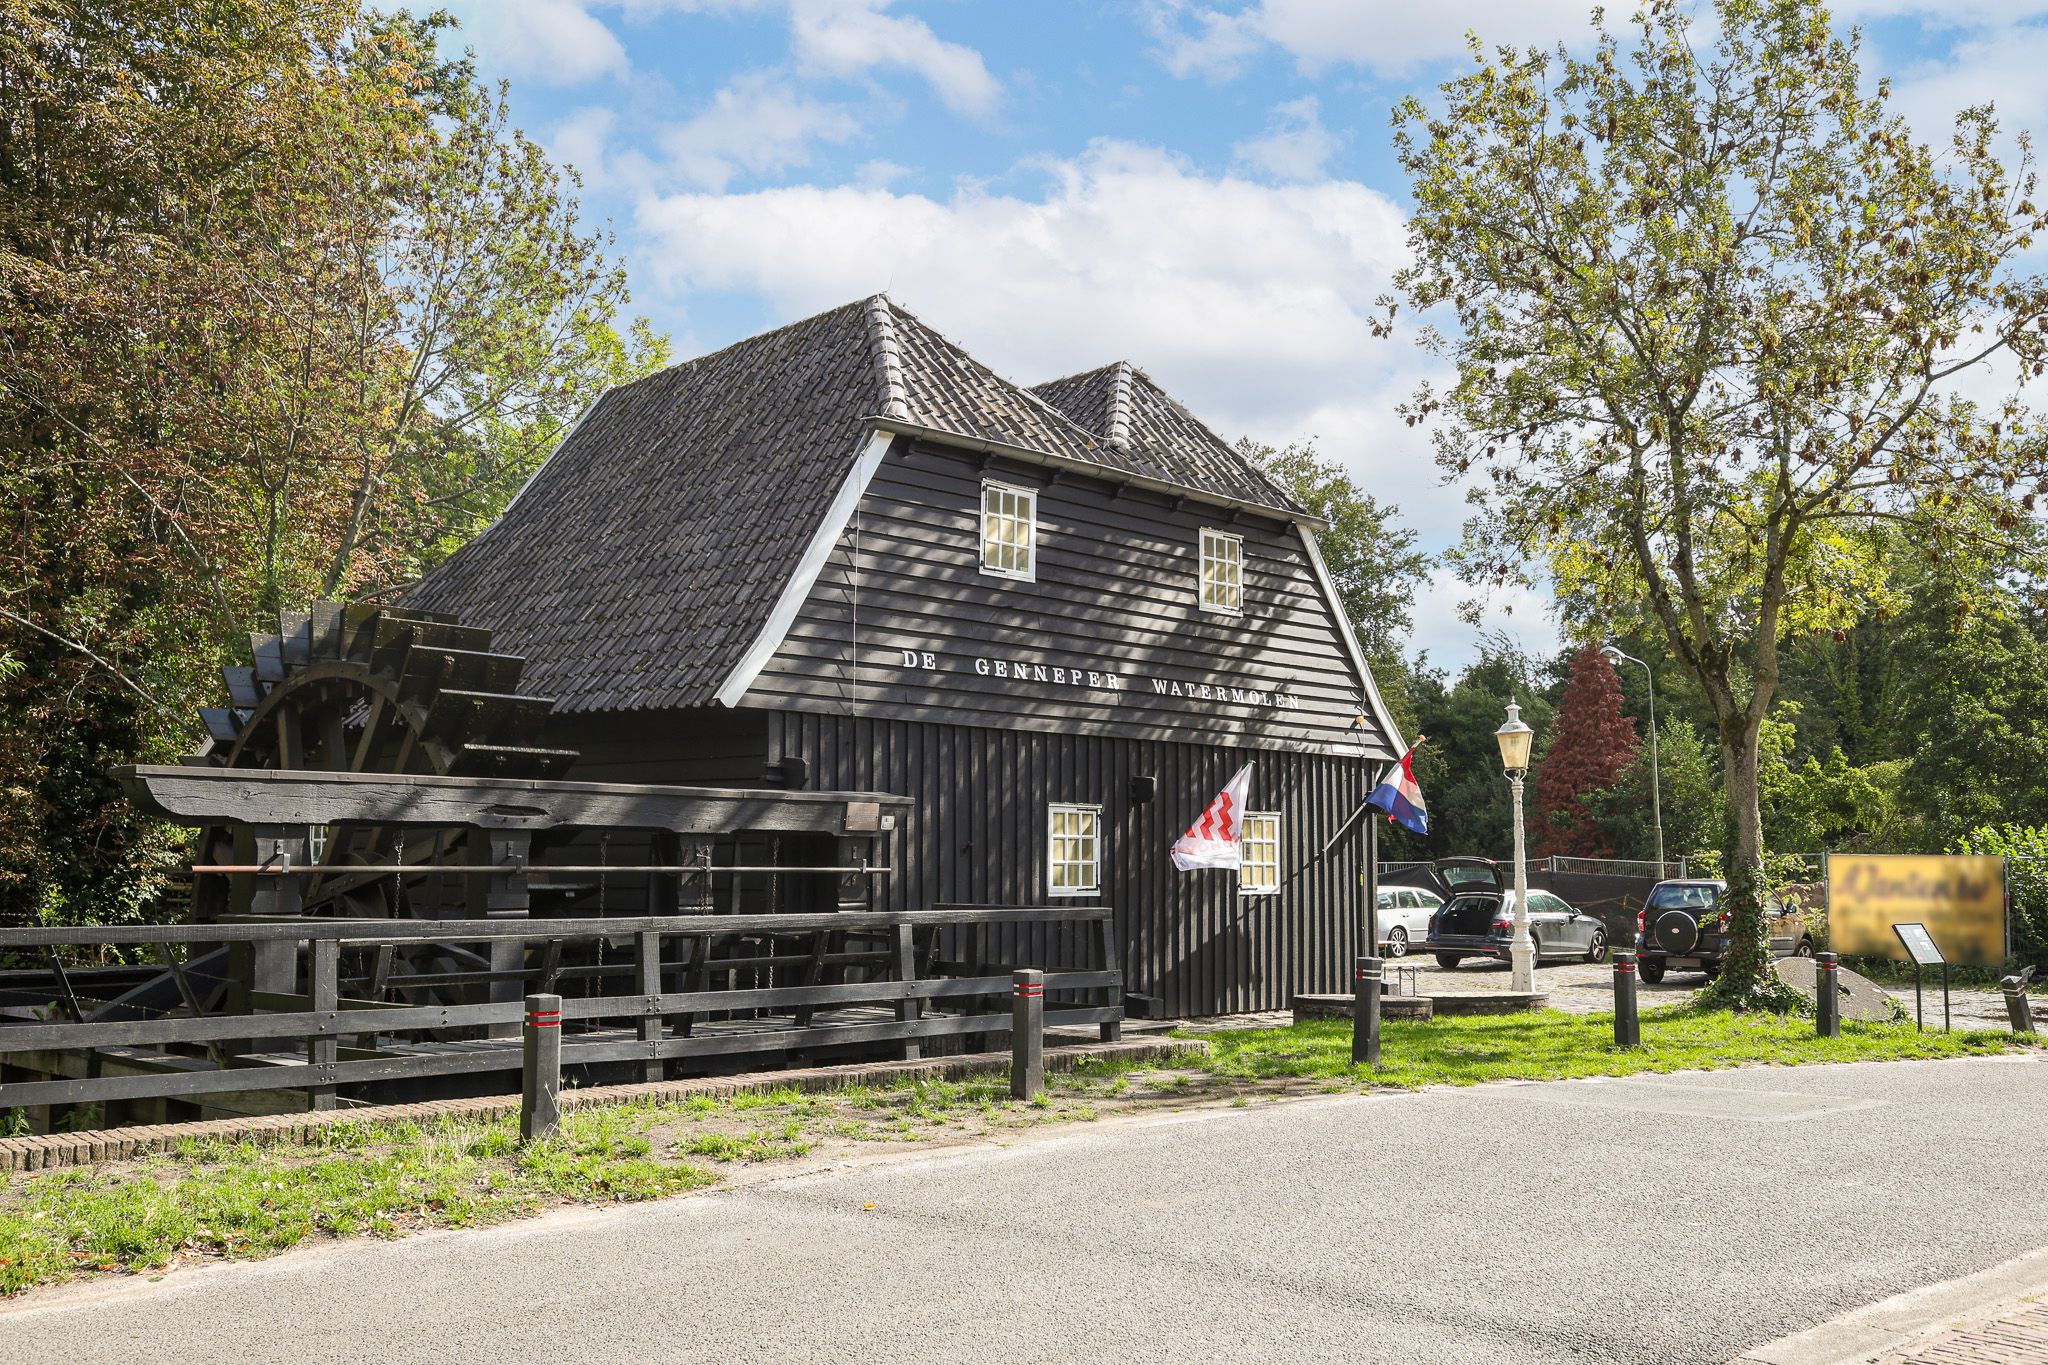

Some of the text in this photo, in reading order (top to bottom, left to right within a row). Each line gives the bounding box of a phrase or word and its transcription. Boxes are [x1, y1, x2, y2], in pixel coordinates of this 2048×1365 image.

[902, 650, 1299, 709] DE GENNEPER WATERMOLEN
